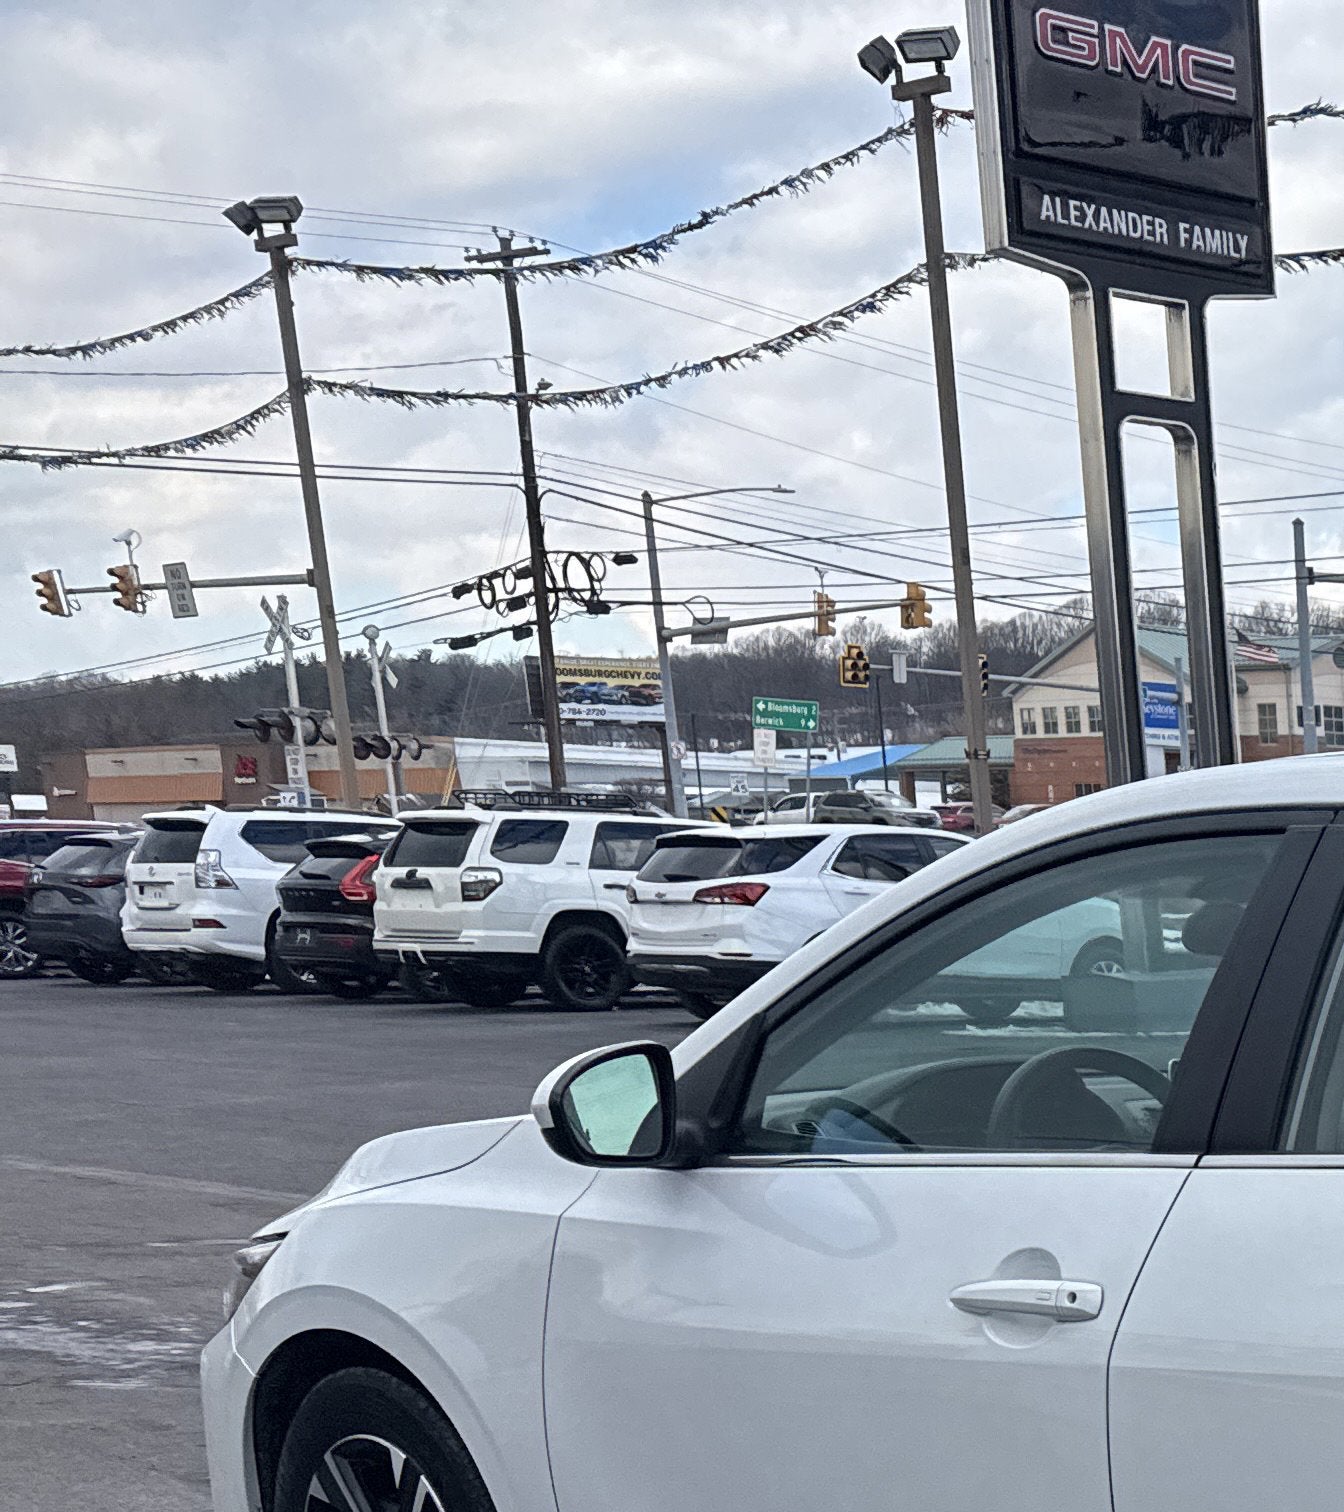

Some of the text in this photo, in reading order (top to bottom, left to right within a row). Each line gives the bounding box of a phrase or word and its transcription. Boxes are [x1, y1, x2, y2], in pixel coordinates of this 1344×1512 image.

[1035, 8, 1237, 102] GMC
[1040, 194, 1249, 260] ALEXANDER FAMILY
[767, 701, 817, 716] Bloomsburg 2
